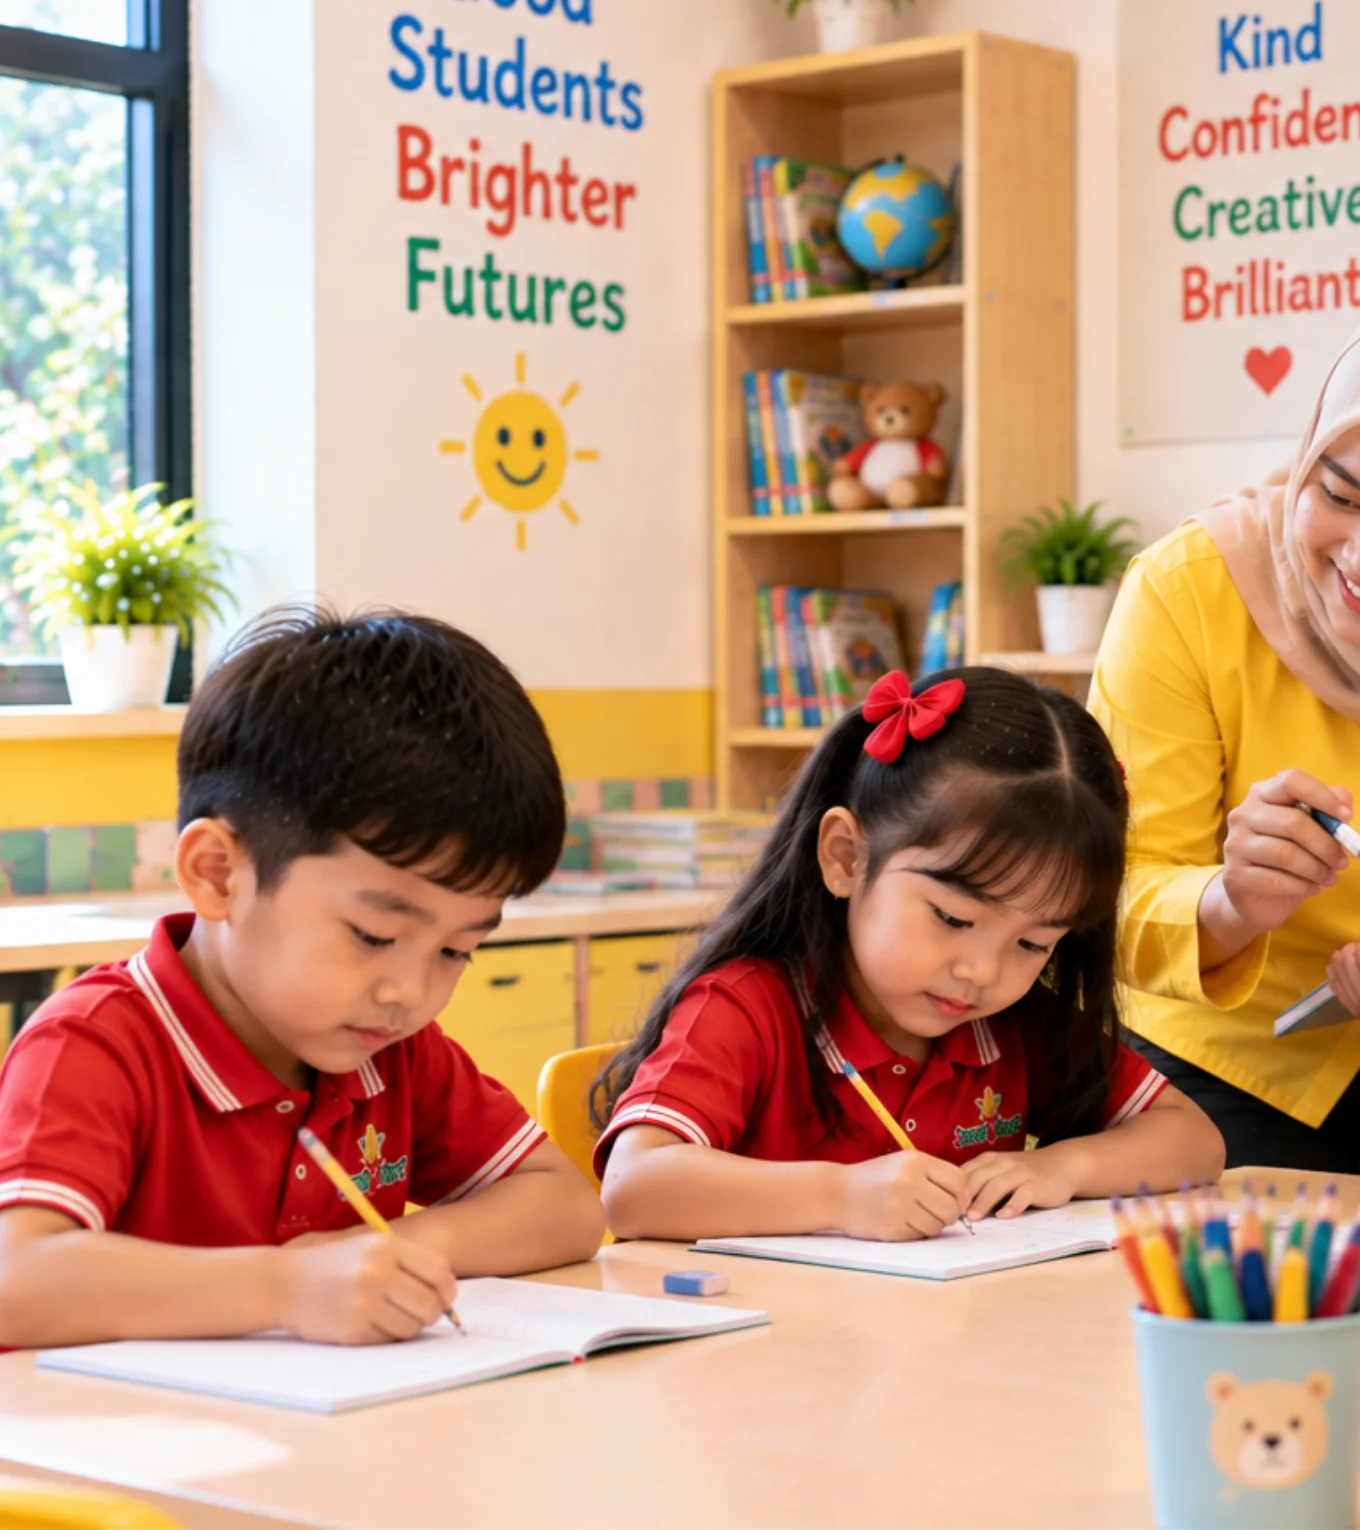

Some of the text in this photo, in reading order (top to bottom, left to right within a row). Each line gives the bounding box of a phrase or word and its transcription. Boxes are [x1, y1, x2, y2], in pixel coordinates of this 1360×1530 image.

[388, 14, 643, 131] Students
[1219, 1, 1323, 74] Kind
[397, 124, 636, 238] Brighter
[406, 236, 626, 333] Futures
